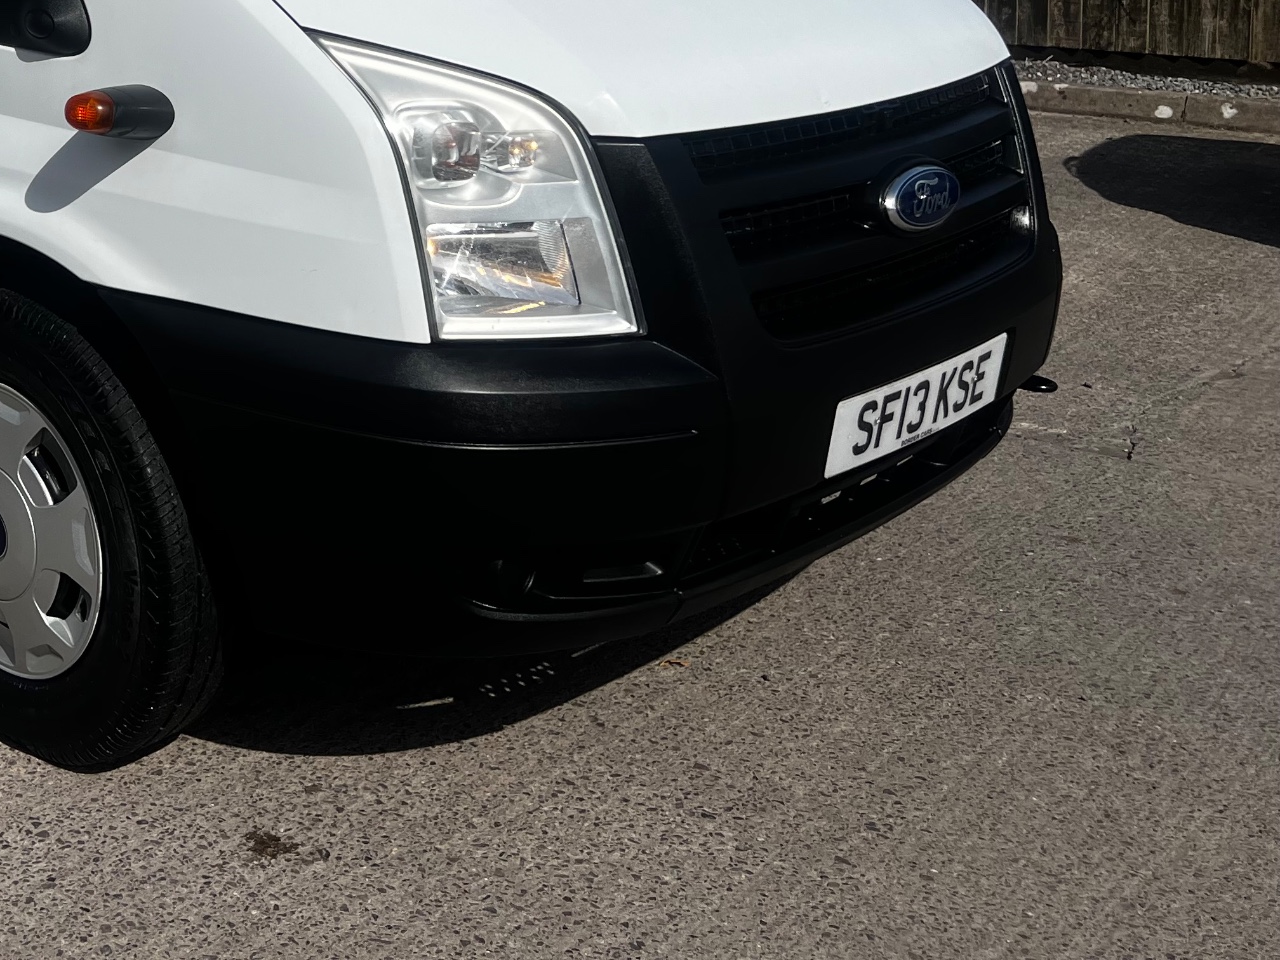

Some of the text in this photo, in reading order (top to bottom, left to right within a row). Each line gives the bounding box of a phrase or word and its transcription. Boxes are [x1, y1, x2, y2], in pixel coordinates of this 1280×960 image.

[913, 174, 951, 217] Ford
[852, 350, 993, 456] SF13 KSE
